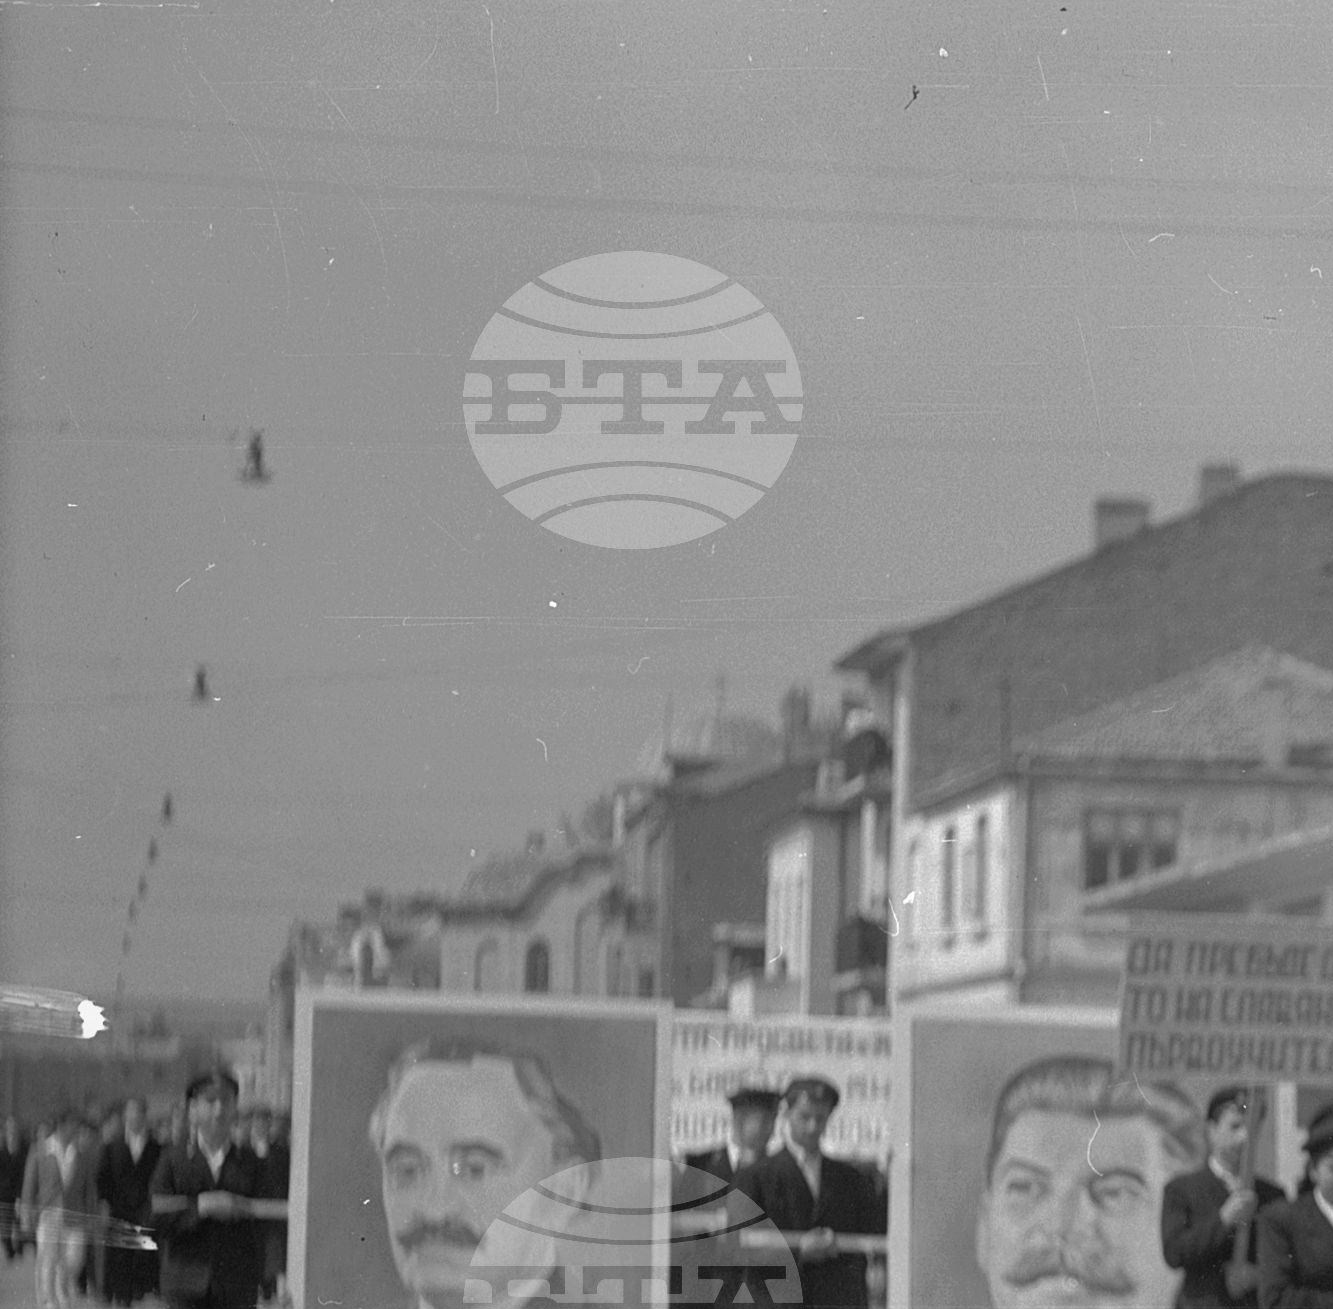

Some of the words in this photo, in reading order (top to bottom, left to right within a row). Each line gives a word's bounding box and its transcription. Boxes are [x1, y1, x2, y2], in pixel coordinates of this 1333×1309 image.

[1126, 937, 1175, 976] ДА
[1126, 983, 1168, 1024] ТО
[1174, 985, 1214, 1026] НА
